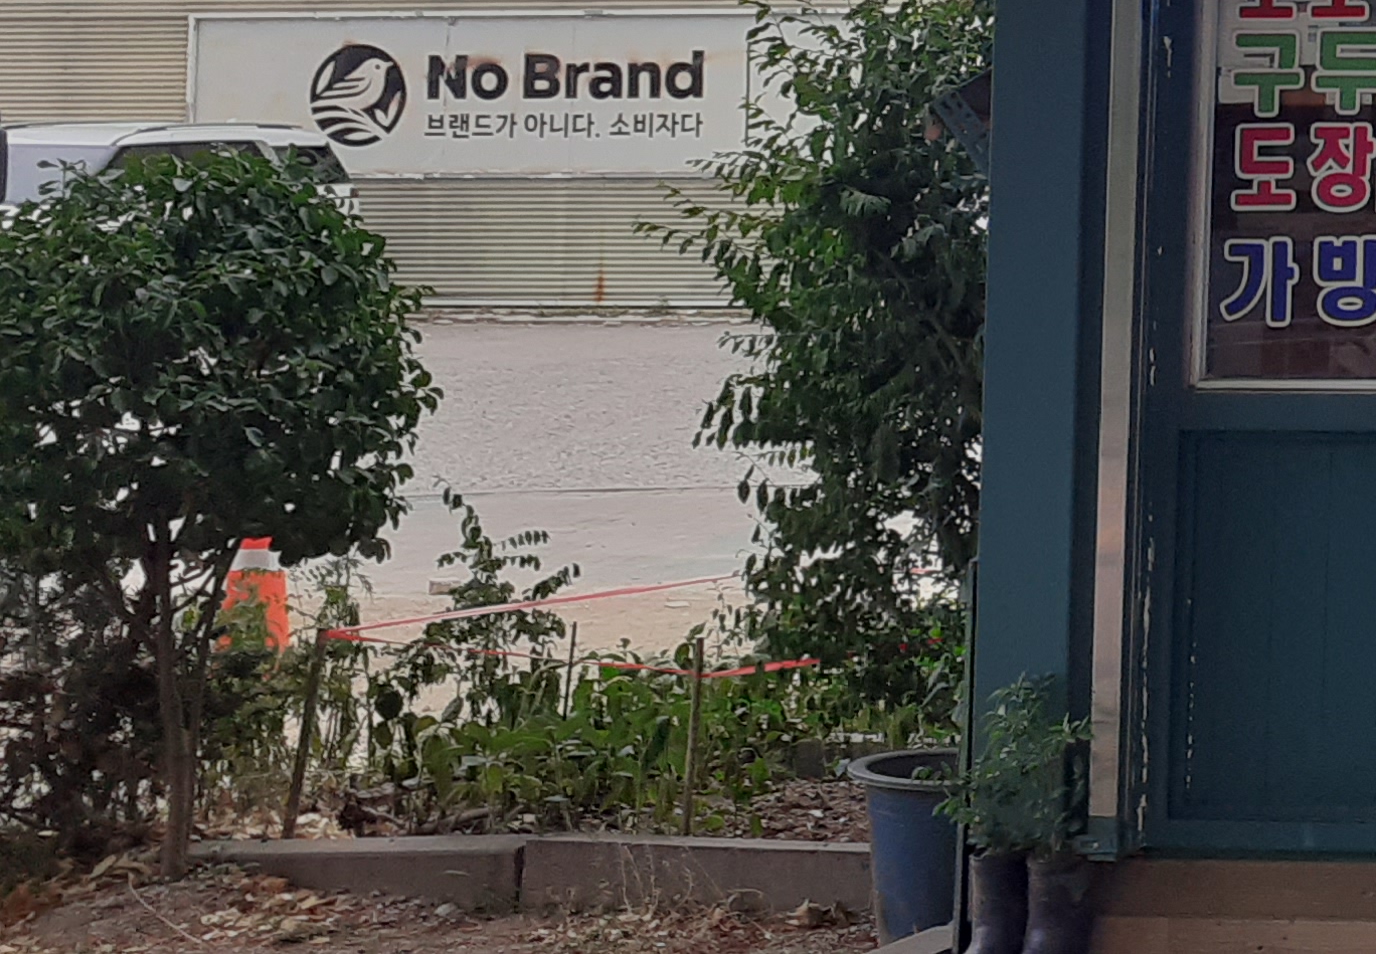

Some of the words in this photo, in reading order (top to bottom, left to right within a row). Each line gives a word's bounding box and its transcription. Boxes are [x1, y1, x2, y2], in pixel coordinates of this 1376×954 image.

[427, 55, 508, 100] No
[522, 50, 705, 99] Brand
[424, 113, 517, 138] 브랜드가
[524, 112, 600, 138] 아니다.
[609, 112, 704, 138] 소비자다
